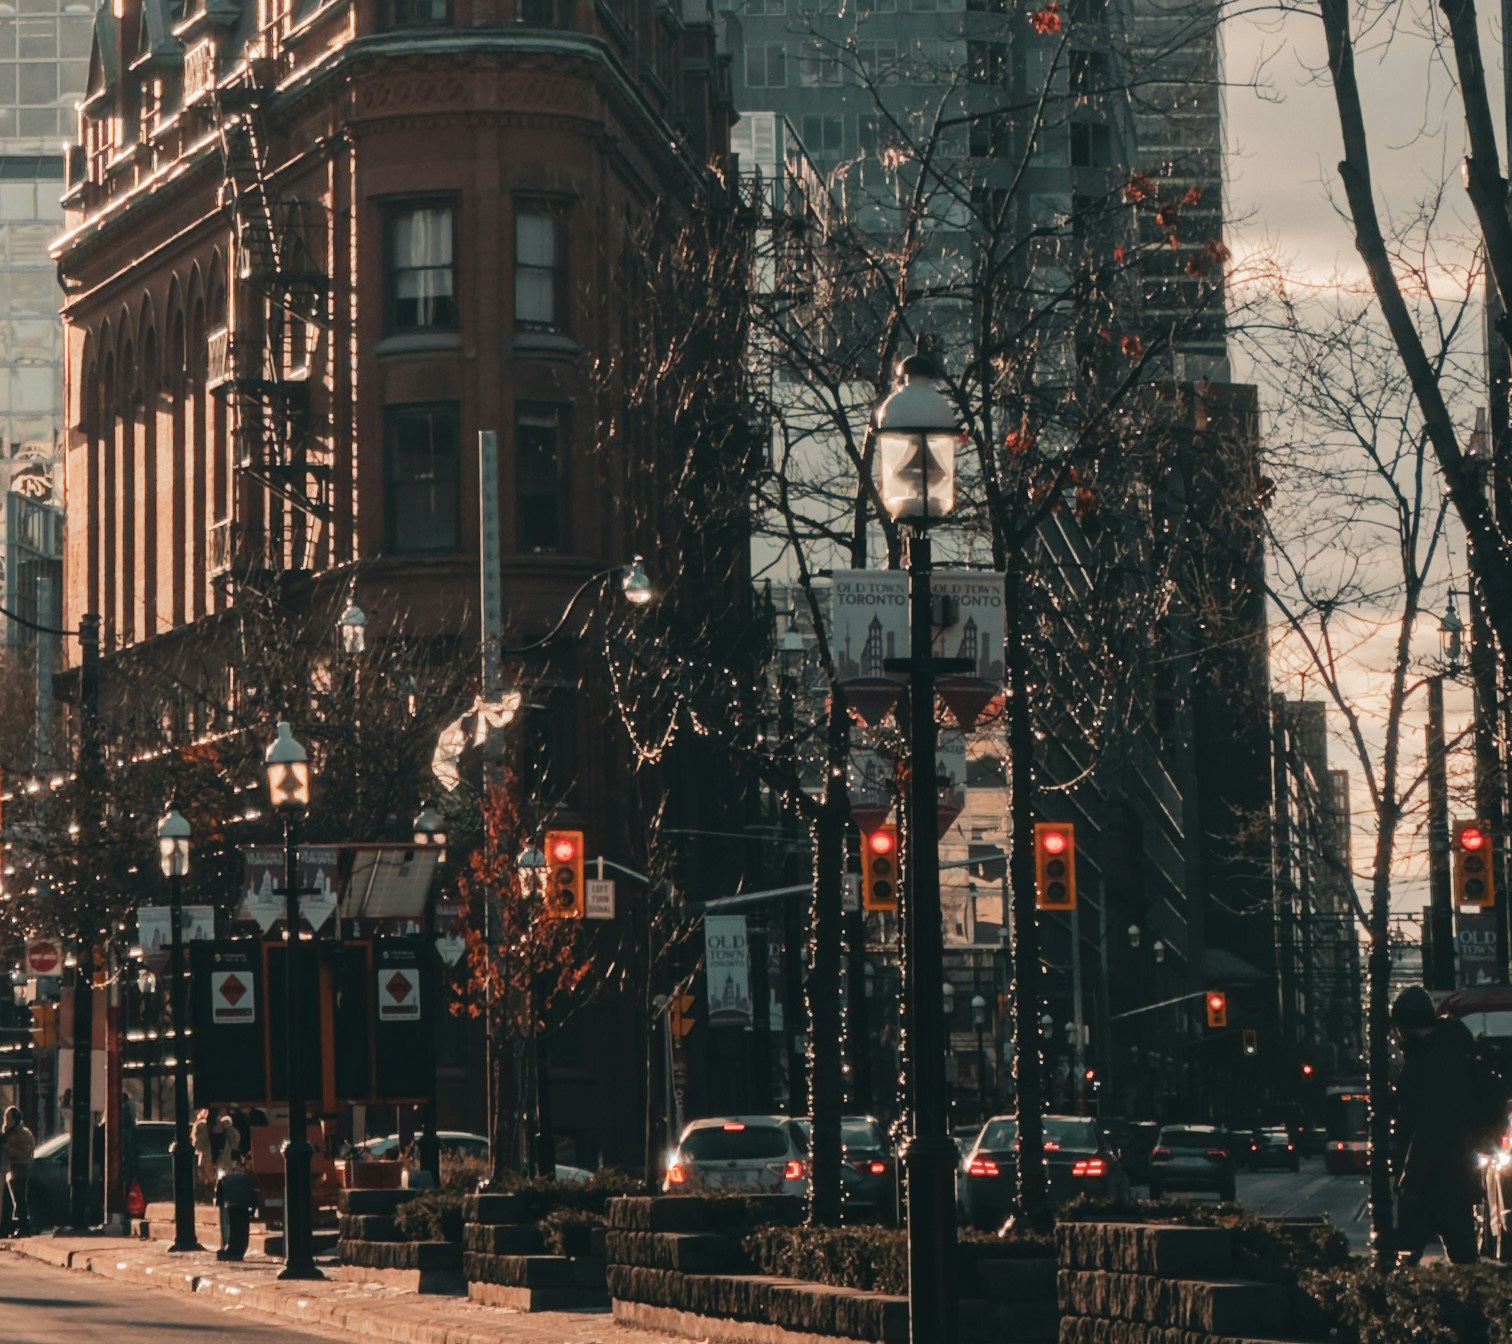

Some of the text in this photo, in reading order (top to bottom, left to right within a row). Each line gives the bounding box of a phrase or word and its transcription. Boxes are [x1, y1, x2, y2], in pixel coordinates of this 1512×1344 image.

[836, 582, 905, 594] OLD TOWN
[932, 583, 1001, 595] OLD TOWN
[838, 593, 906, 606] TORONTO
[591, 884, 609, 893] LEFT
[592, 895, 609, 903] TURN
[588, 905, 611, 914] SIGNAL
[708, 935, 745, 949] OLD
[1459, 930, 1497, 944] OLD
[709, 950, 745, 960] TOWN
[1460, 944, 1497, 955] TOWN
[710, 960, 745, 968] TORONTO
